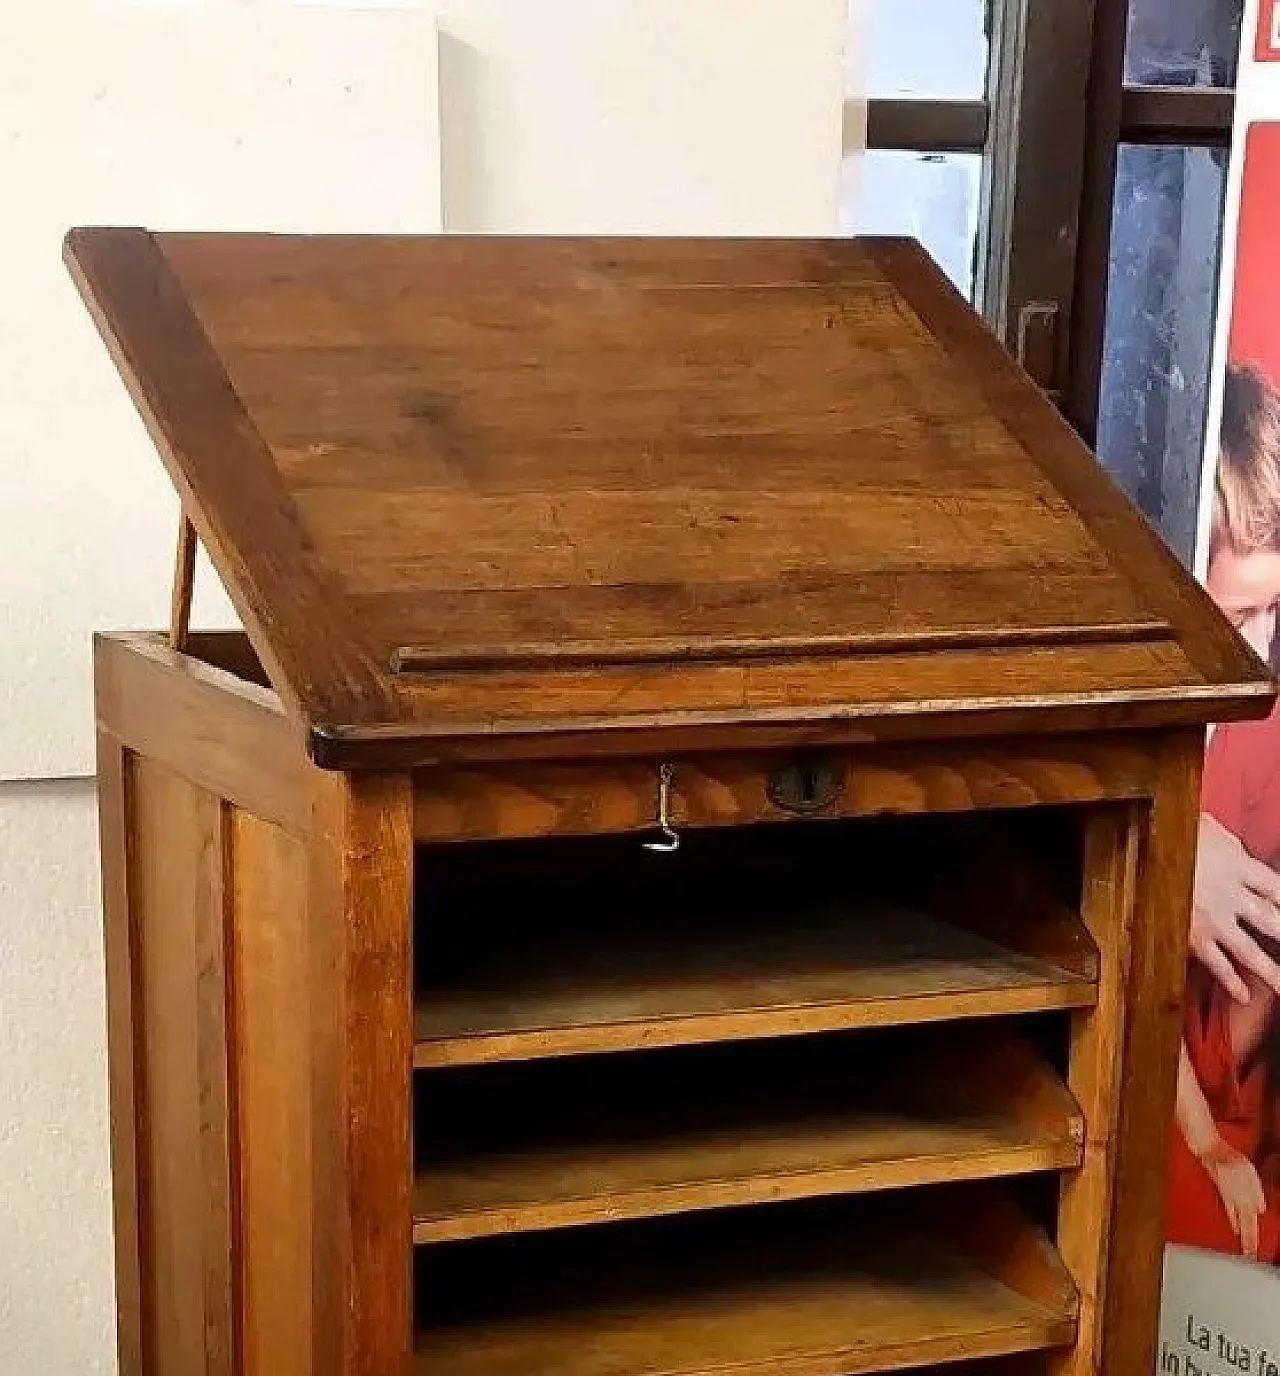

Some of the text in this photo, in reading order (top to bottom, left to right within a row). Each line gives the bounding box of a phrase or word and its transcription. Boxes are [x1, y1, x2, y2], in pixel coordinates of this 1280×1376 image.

[1161, 1341, 1180, 1376] in
[1187, 1314, 1210, 1351] La
[1217, 1334, 1251, 1372] tua
